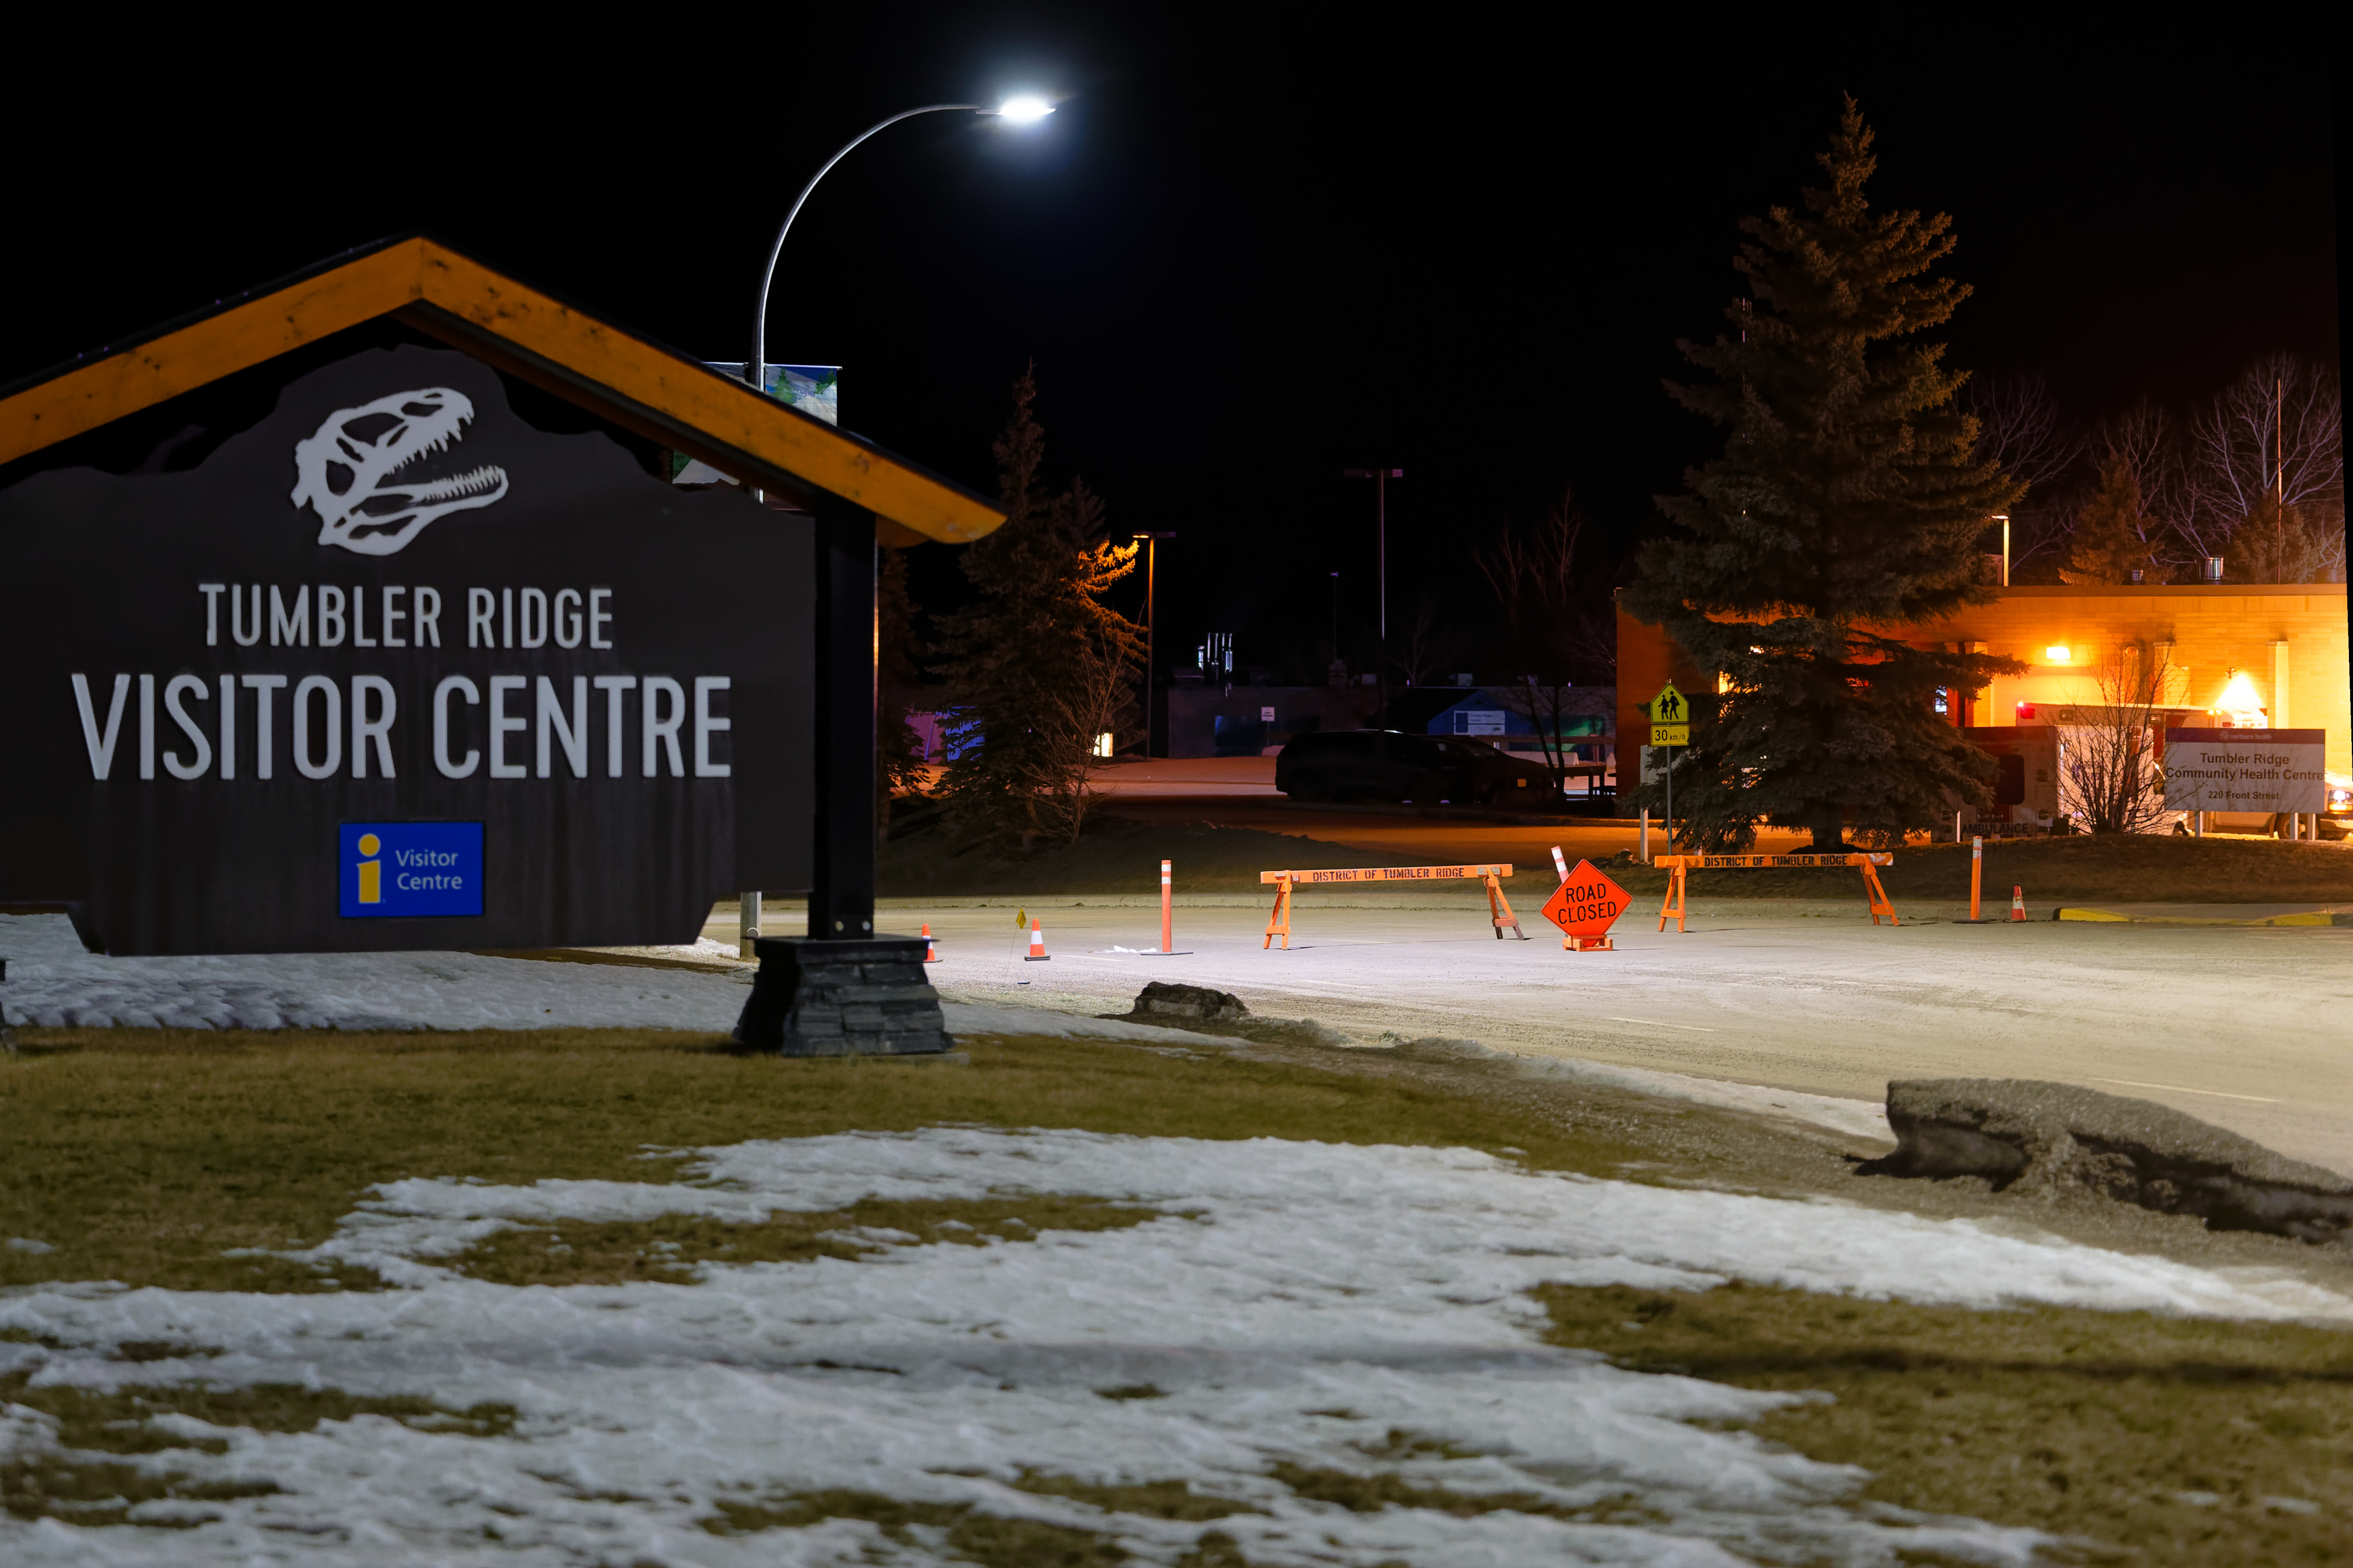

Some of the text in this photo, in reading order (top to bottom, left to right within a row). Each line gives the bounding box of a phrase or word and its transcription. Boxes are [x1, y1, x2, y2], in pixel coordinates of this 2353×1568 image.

[198, 583, 613, 649] TUMBLER RIDGE
[71, 673, 731, 780] VISITOR CENTRE
[1655, 730, 1668, 741] 30
[2200, 753, 2289, 766] Tumbler Ridge
[2165, 767, 2324, 781] Community Health Centre
[2208, 790, 2279, 800] 220 Front Street
[1962, 823, 2028, 834] AMBULANCE
[395, 849, 459, 867] Visitor
[1704, 855, 1847, 867] DISTRICT OF TUMBLER RIDGE
[397, 872, 462, 890] Centre
[1313, 868, 1464, 882] DISTRICT OF TUMBLER RIDGE
[1565, 883, 1606, 903] ROAD
[1558, 901, 1617, 924] CLOSED
